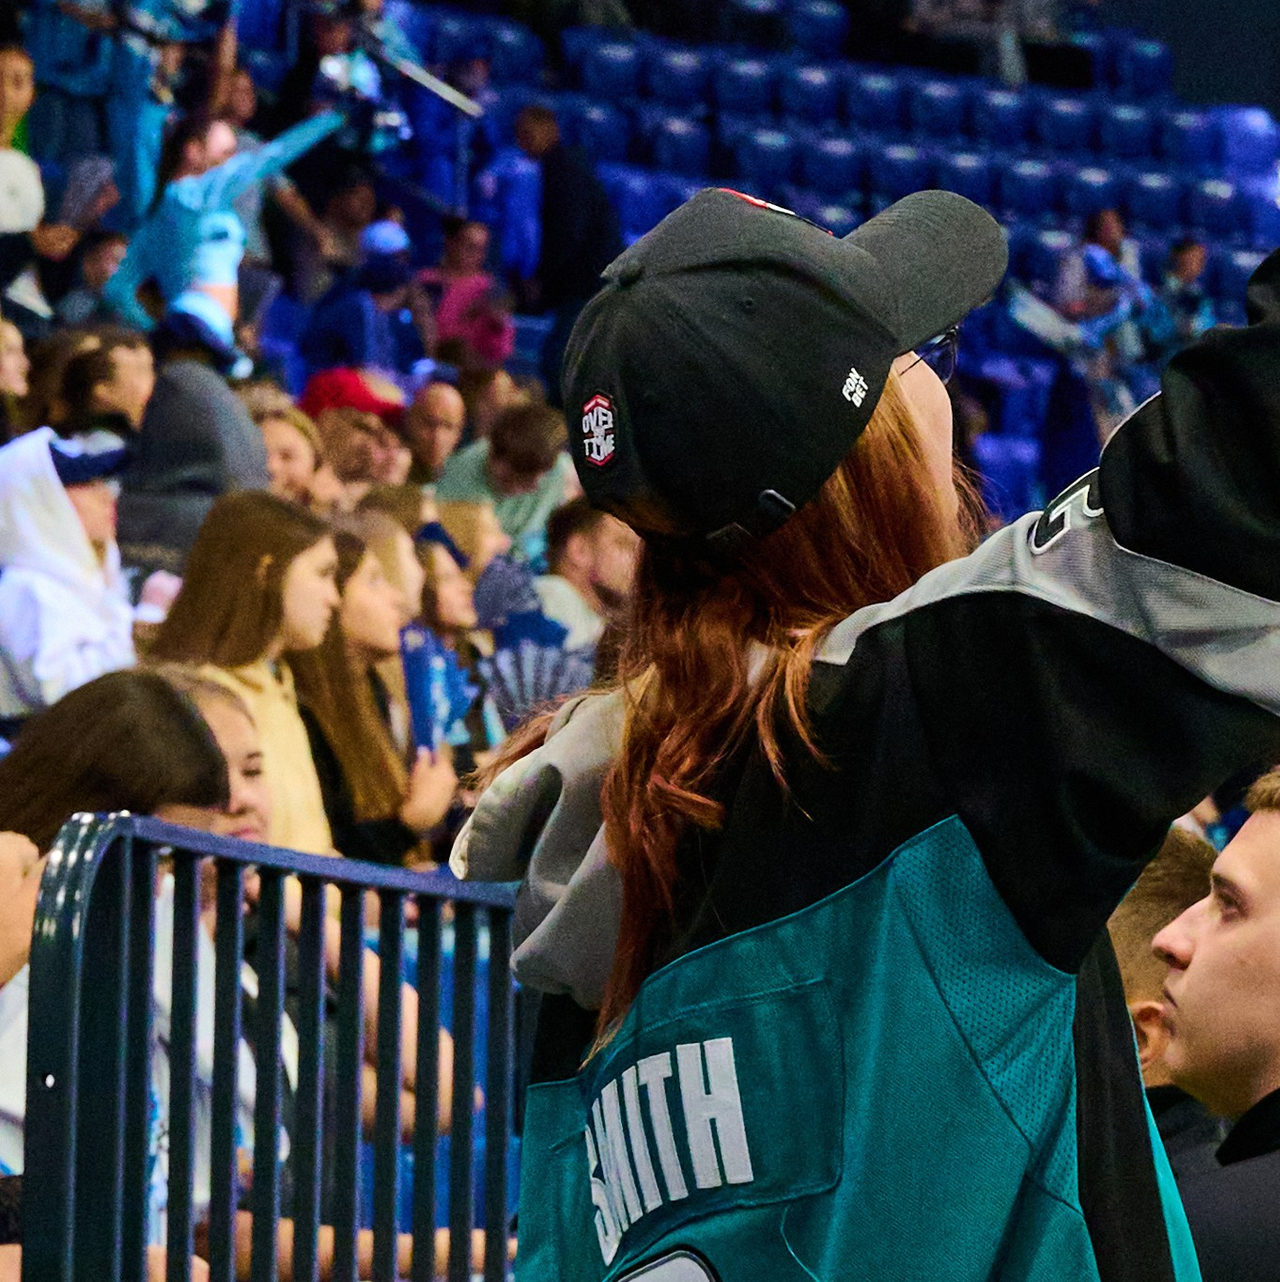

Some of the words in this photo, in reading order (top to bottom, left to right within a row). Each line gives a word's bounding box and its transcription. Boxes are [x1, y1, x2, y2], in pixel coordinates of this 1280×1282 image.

[842, 367, 862, 402] FON
[851, 376, 869, 408] BET
[582, 407, 614, 434] OVER
[583, 434, 615, 461] TIME
[585, 1036, 755, 1267] SMITH
